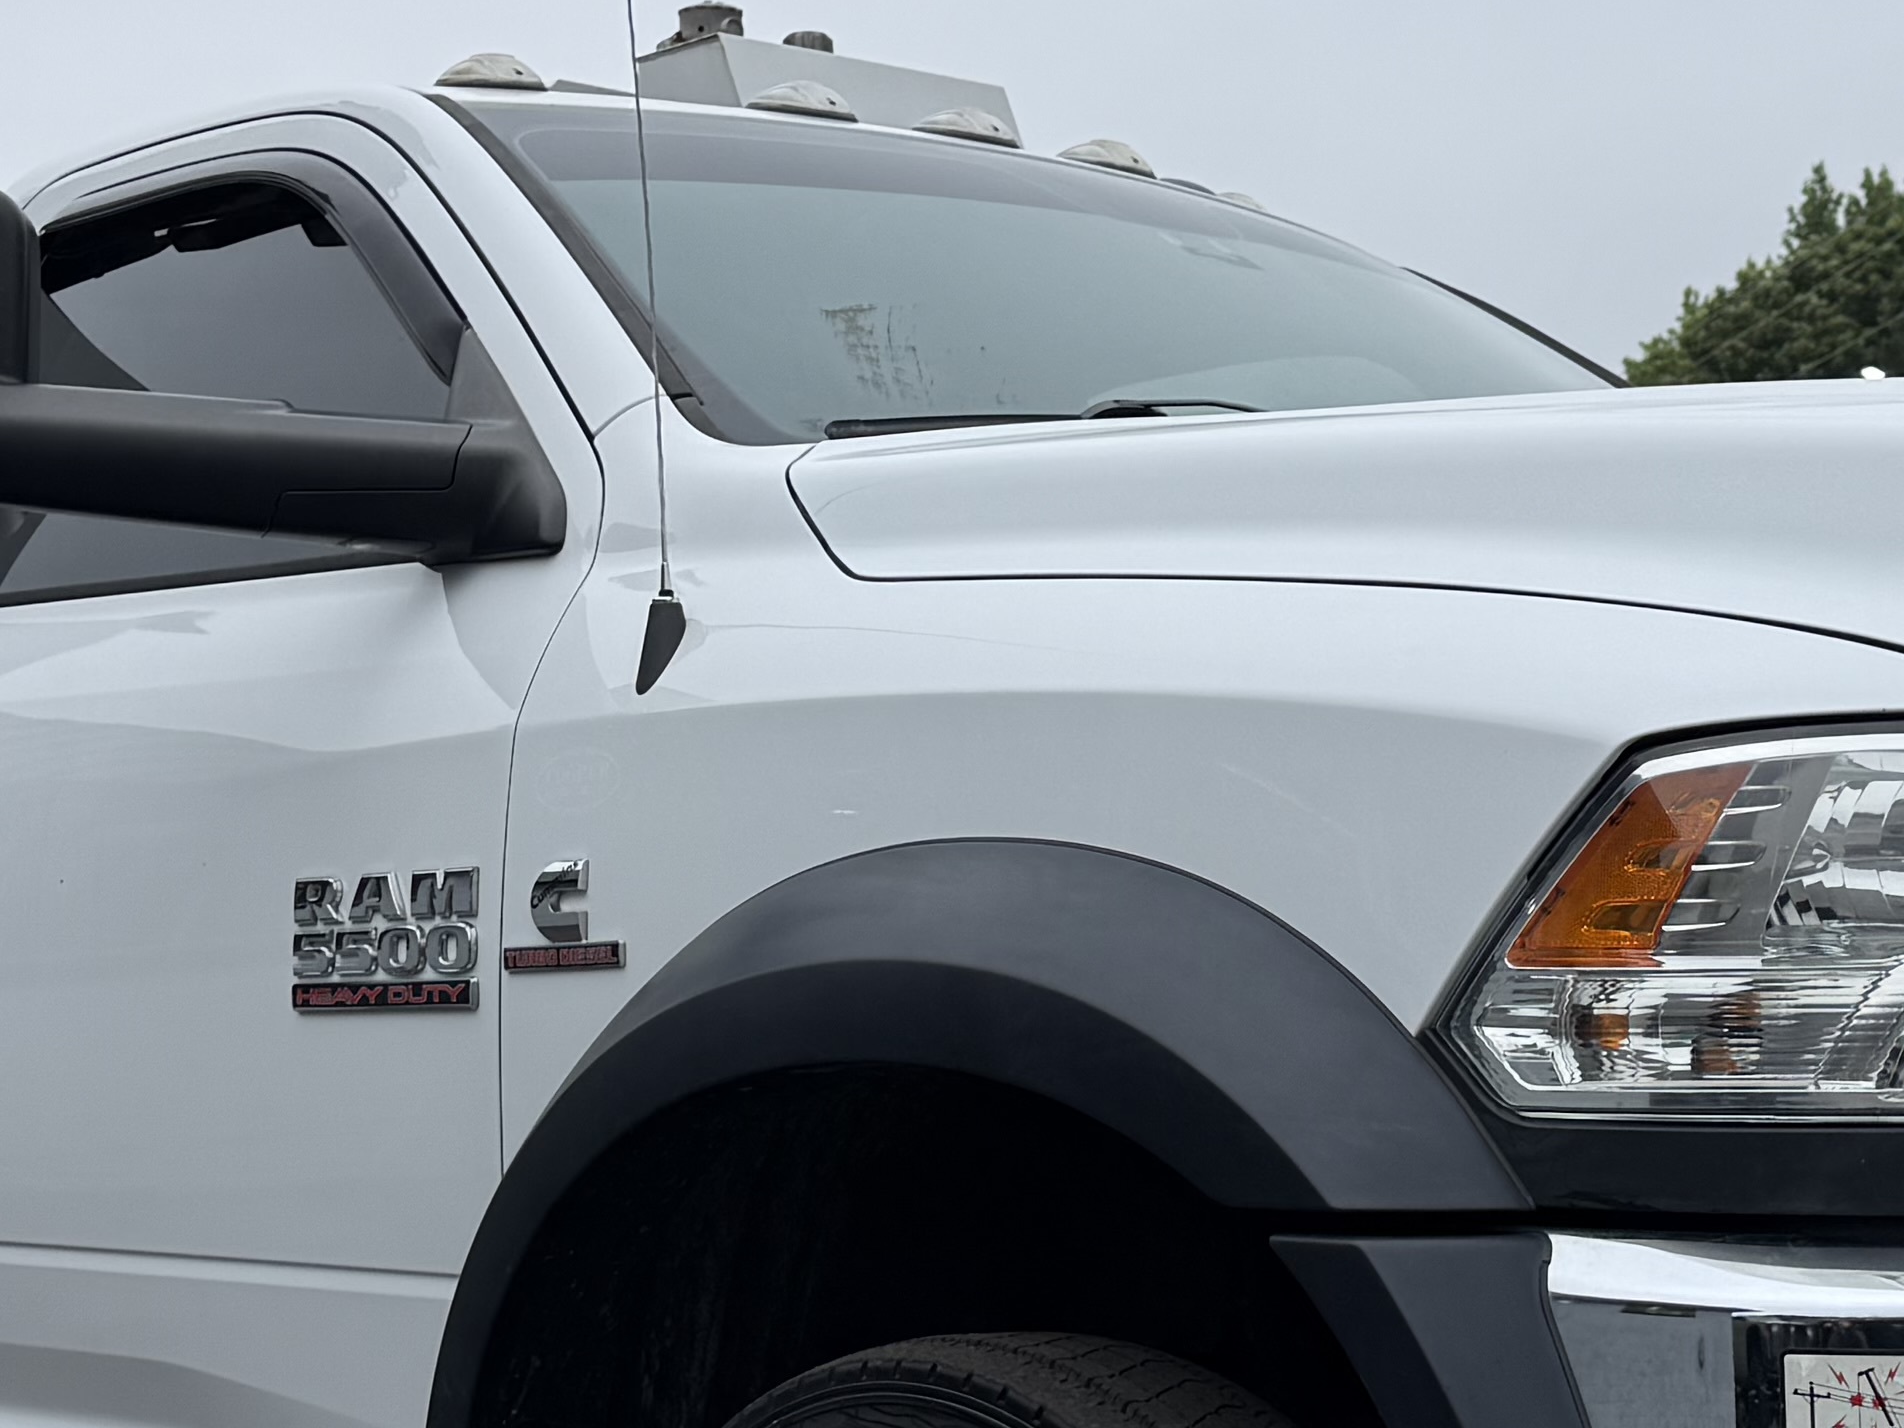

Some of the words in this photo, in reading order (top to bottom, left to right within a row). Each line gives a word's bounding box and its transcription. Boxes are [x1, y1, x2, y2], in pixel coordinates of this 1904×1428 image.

[293, 866, 480, 927] RAM
[292, 920, 479, 978] 5500
[296, 985, 384, 1006] HEAVY
[387, 982, 466, 1005] DUTY
